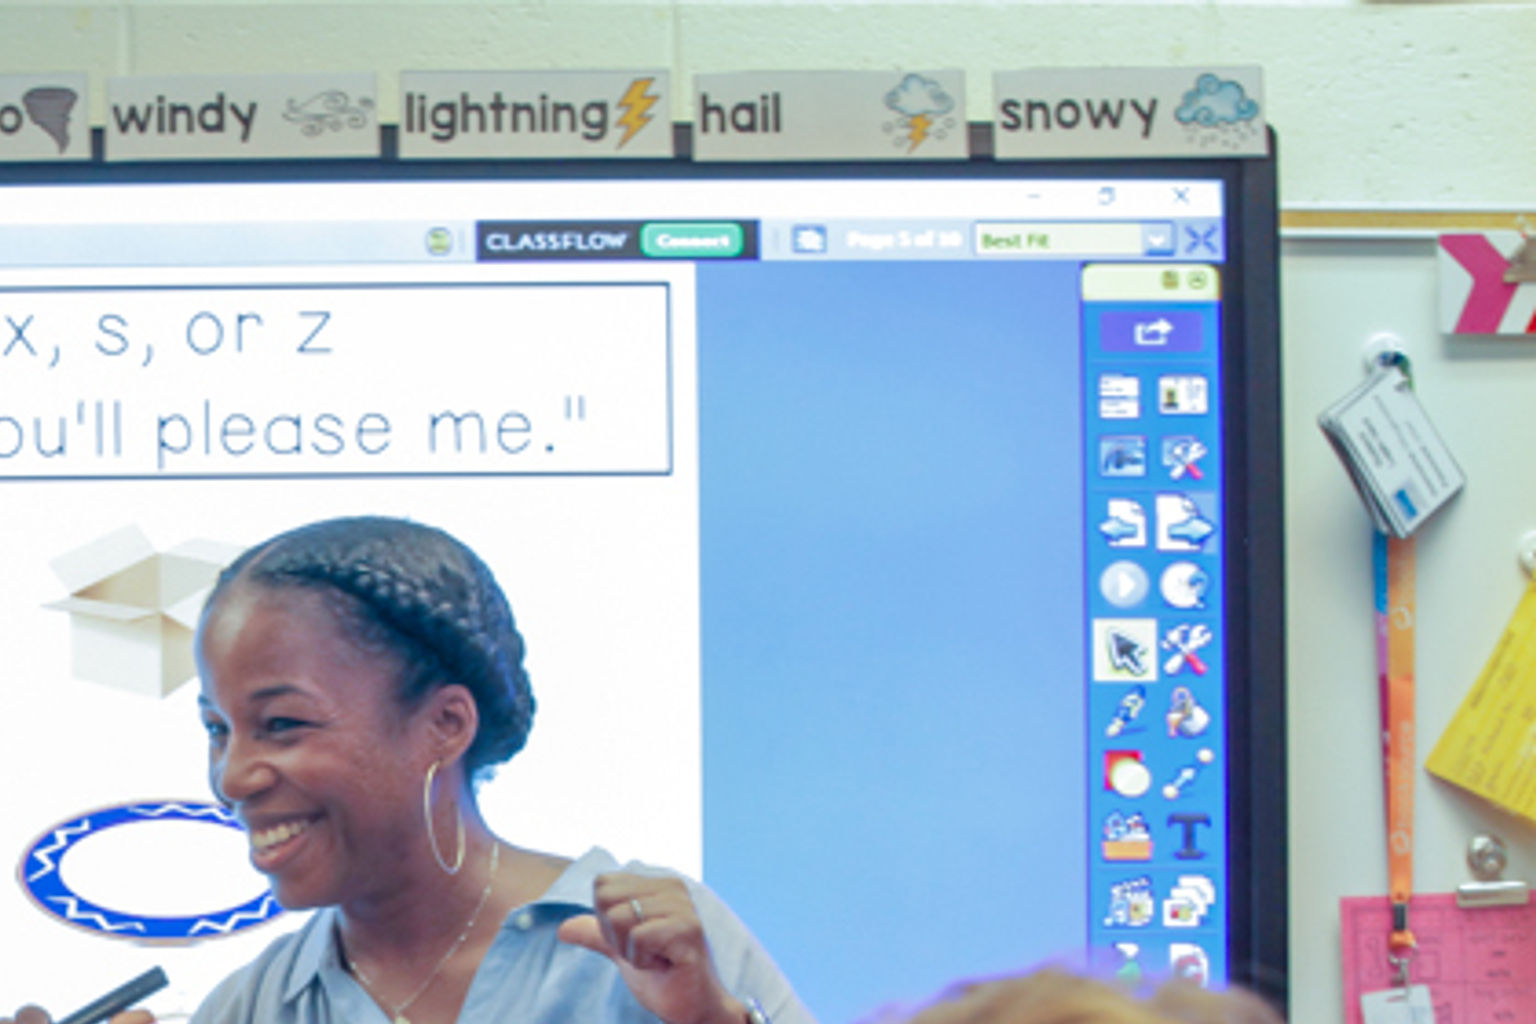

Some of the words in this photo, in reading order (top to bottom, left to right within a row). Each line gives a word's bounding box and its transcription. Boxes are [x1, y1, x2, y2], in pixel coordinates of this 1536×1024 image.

[112, 93, 258, 142] windy
[405, 92, 609, 142] lightning
[700, 92, 781, 134] hail
[1000, 98, 1158, 139] snowy
[485, 232, 628, 251] CLASSFLOW
[655, 233, 730, 248] Connect
[981, 233, 1022, 249] Best
[2, 314, 61, 368] x,
[94, 312, 154, 368] s,
[185, 311, 263, 355] or
[295, 310, 334, 354] z
[156, 397, 393, 470] please
[429, 393, 587, 455] me."
